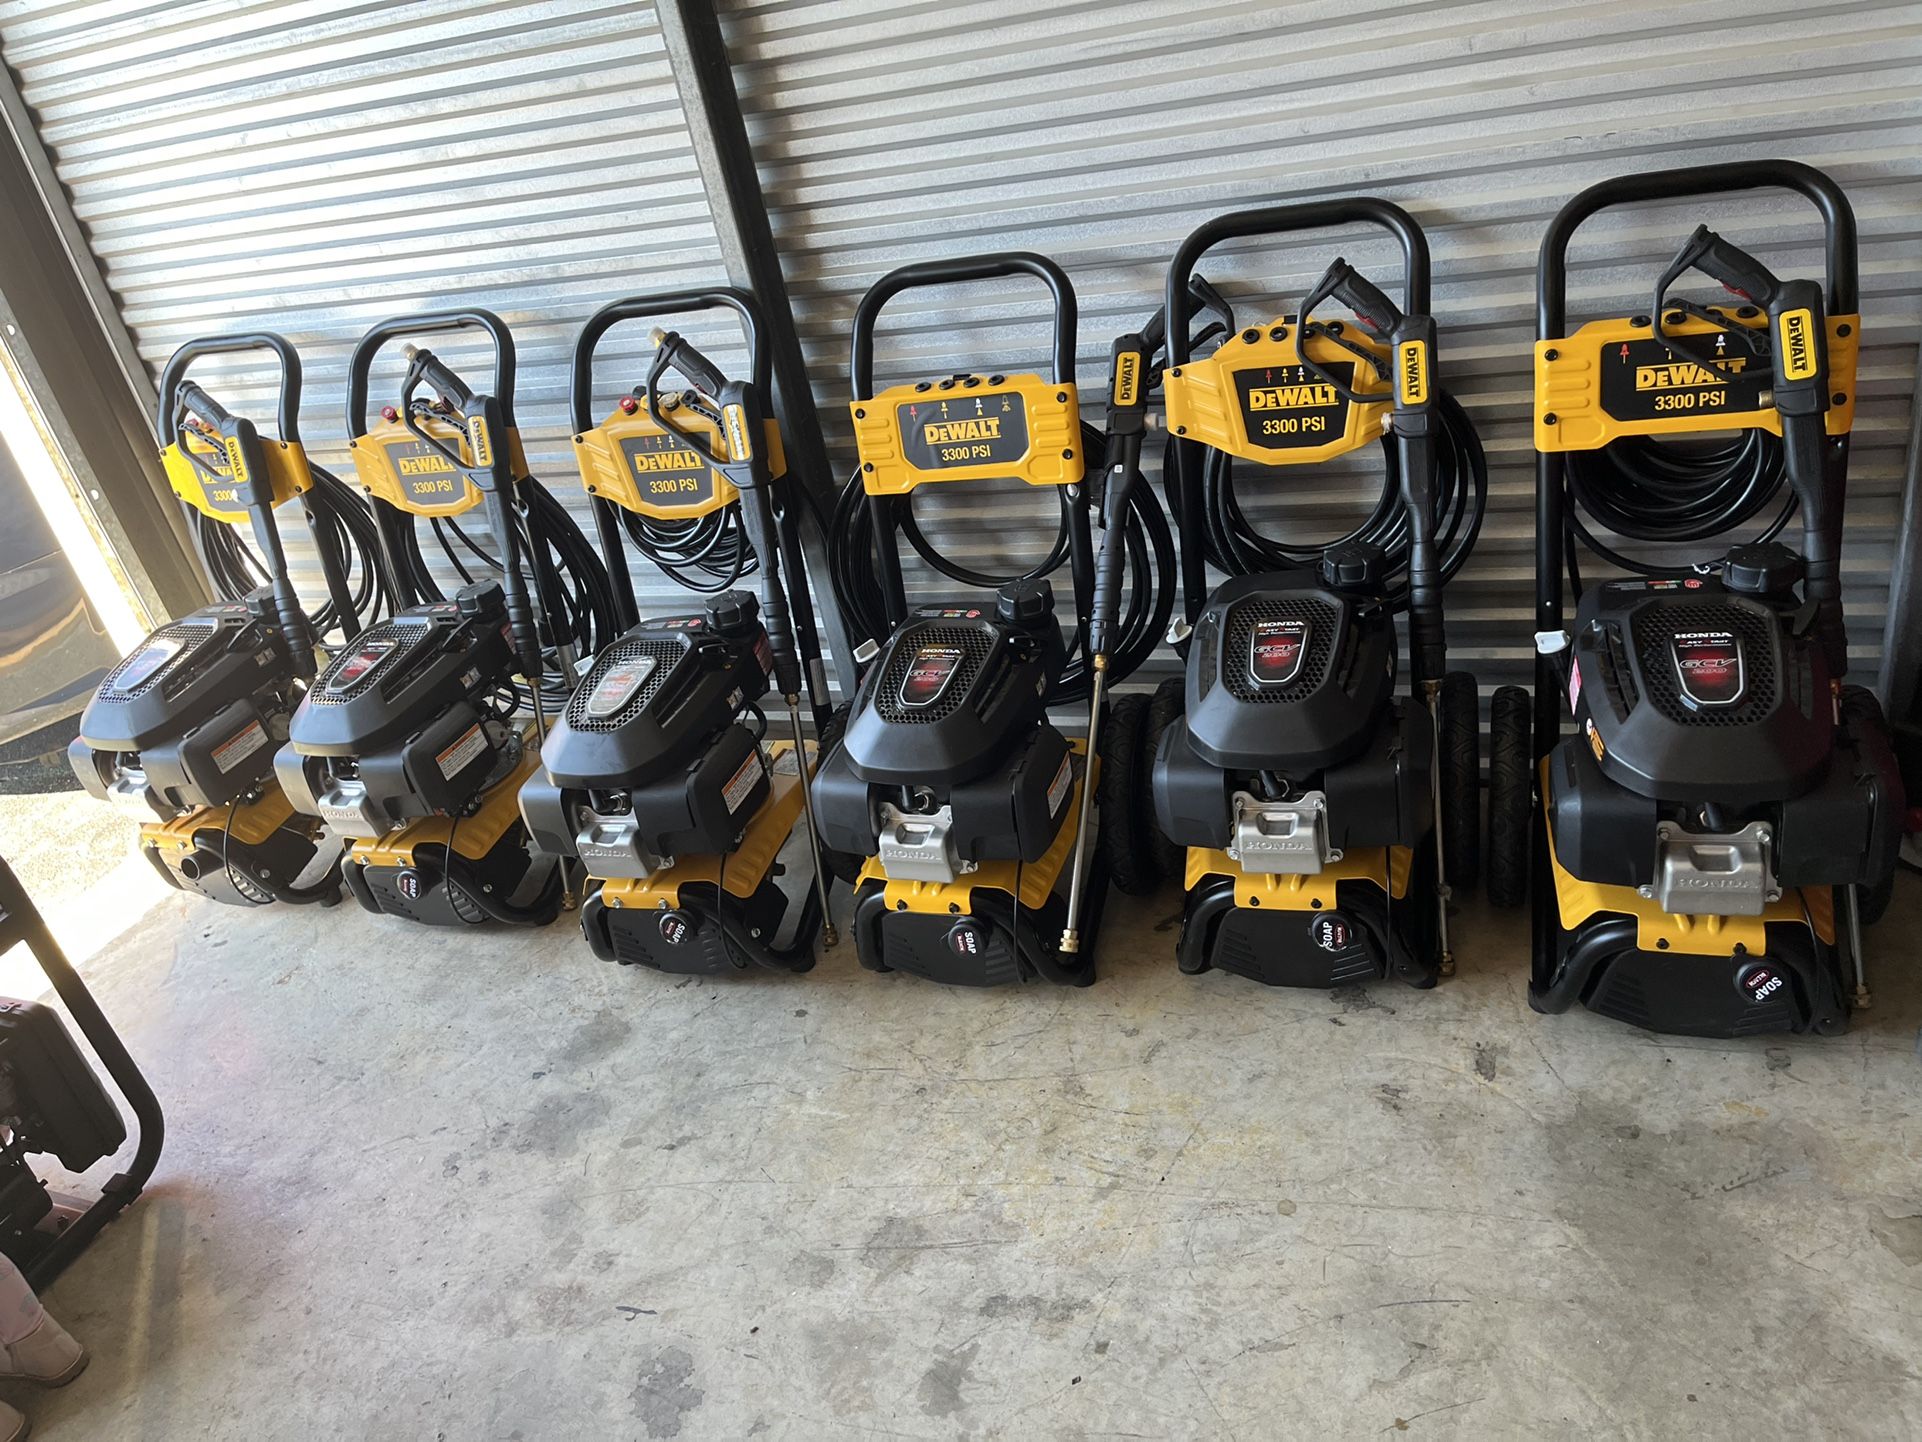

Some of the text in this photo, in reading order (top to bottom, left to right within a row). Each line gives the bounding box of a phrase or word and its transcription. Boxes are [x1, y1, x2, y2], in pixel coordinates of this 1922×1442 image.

[1789, 316, 1806, 372] DEWALT
[1121, 357, 1134, 400] DEWALT
[1405, 347, 1420, 398] DEWALT
[1654, 391, 1725, 411] 3300 PSI
[924, 419, 1000, 443] DEWALT
[1262, 416, 1326, 435] 3300 PSI
[941, 444, 991, 461] 3300 PSI
[413, 479, 453, 493] 3300 PSI
[649, 478, 698, 494] 3300 PSI
[886, 850, 942, 860] HONDA
[1246, 841, 1313, 851] HONDA
[409, 877, 417, 898] SOAP
[672, 923, 686, 943] SOAP
[964, 932, 977, 954] SOAP
[1322, 921, 1333, 948] SOAP
[1755, 976, 1783, 1000] SOAP
